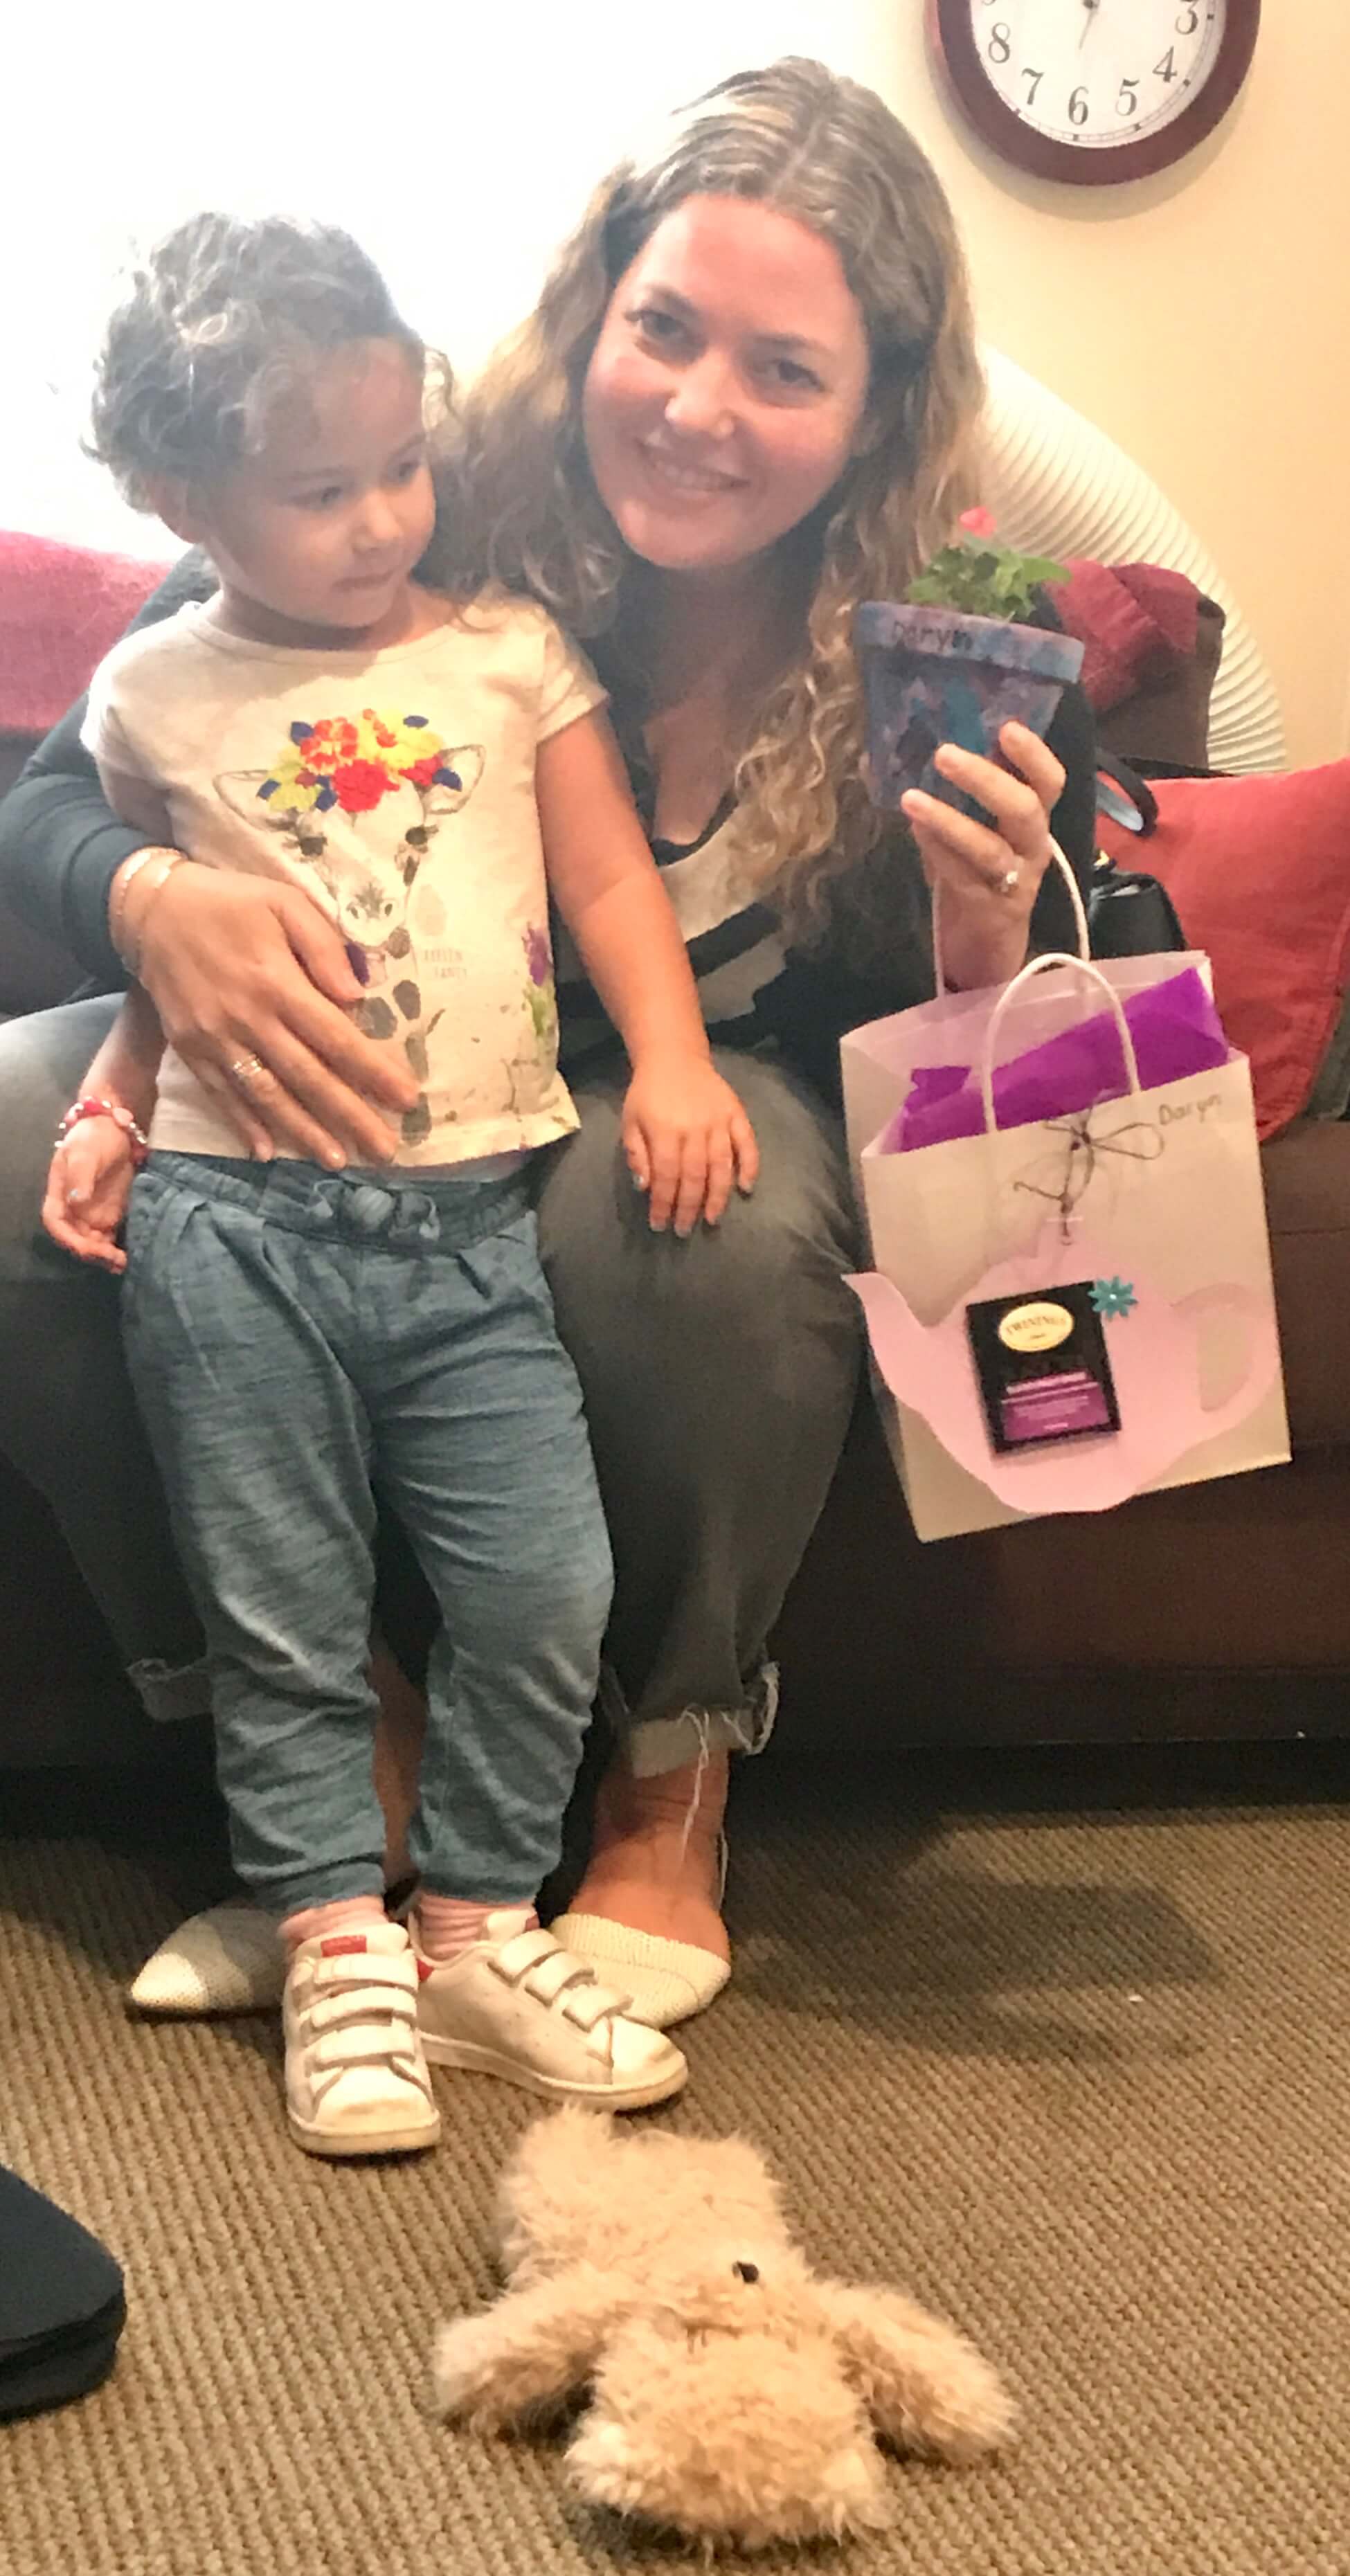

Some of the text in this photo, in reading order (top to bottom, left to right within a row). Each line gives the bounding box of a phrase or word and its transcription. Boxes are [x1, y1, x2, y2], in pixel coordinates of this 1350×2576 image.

[988, 22, 1011, 64] 8
[1152, 46, 1178, 83] 4
[1020, 68, 1044, 106] 7
[1068, 86, 1088, 125] 6
[1115, 78, 1140, 116] 5
[1158, 1094, 1223, 1126] Daryn
[1006, 1315, 1067, 1335] TWININ
